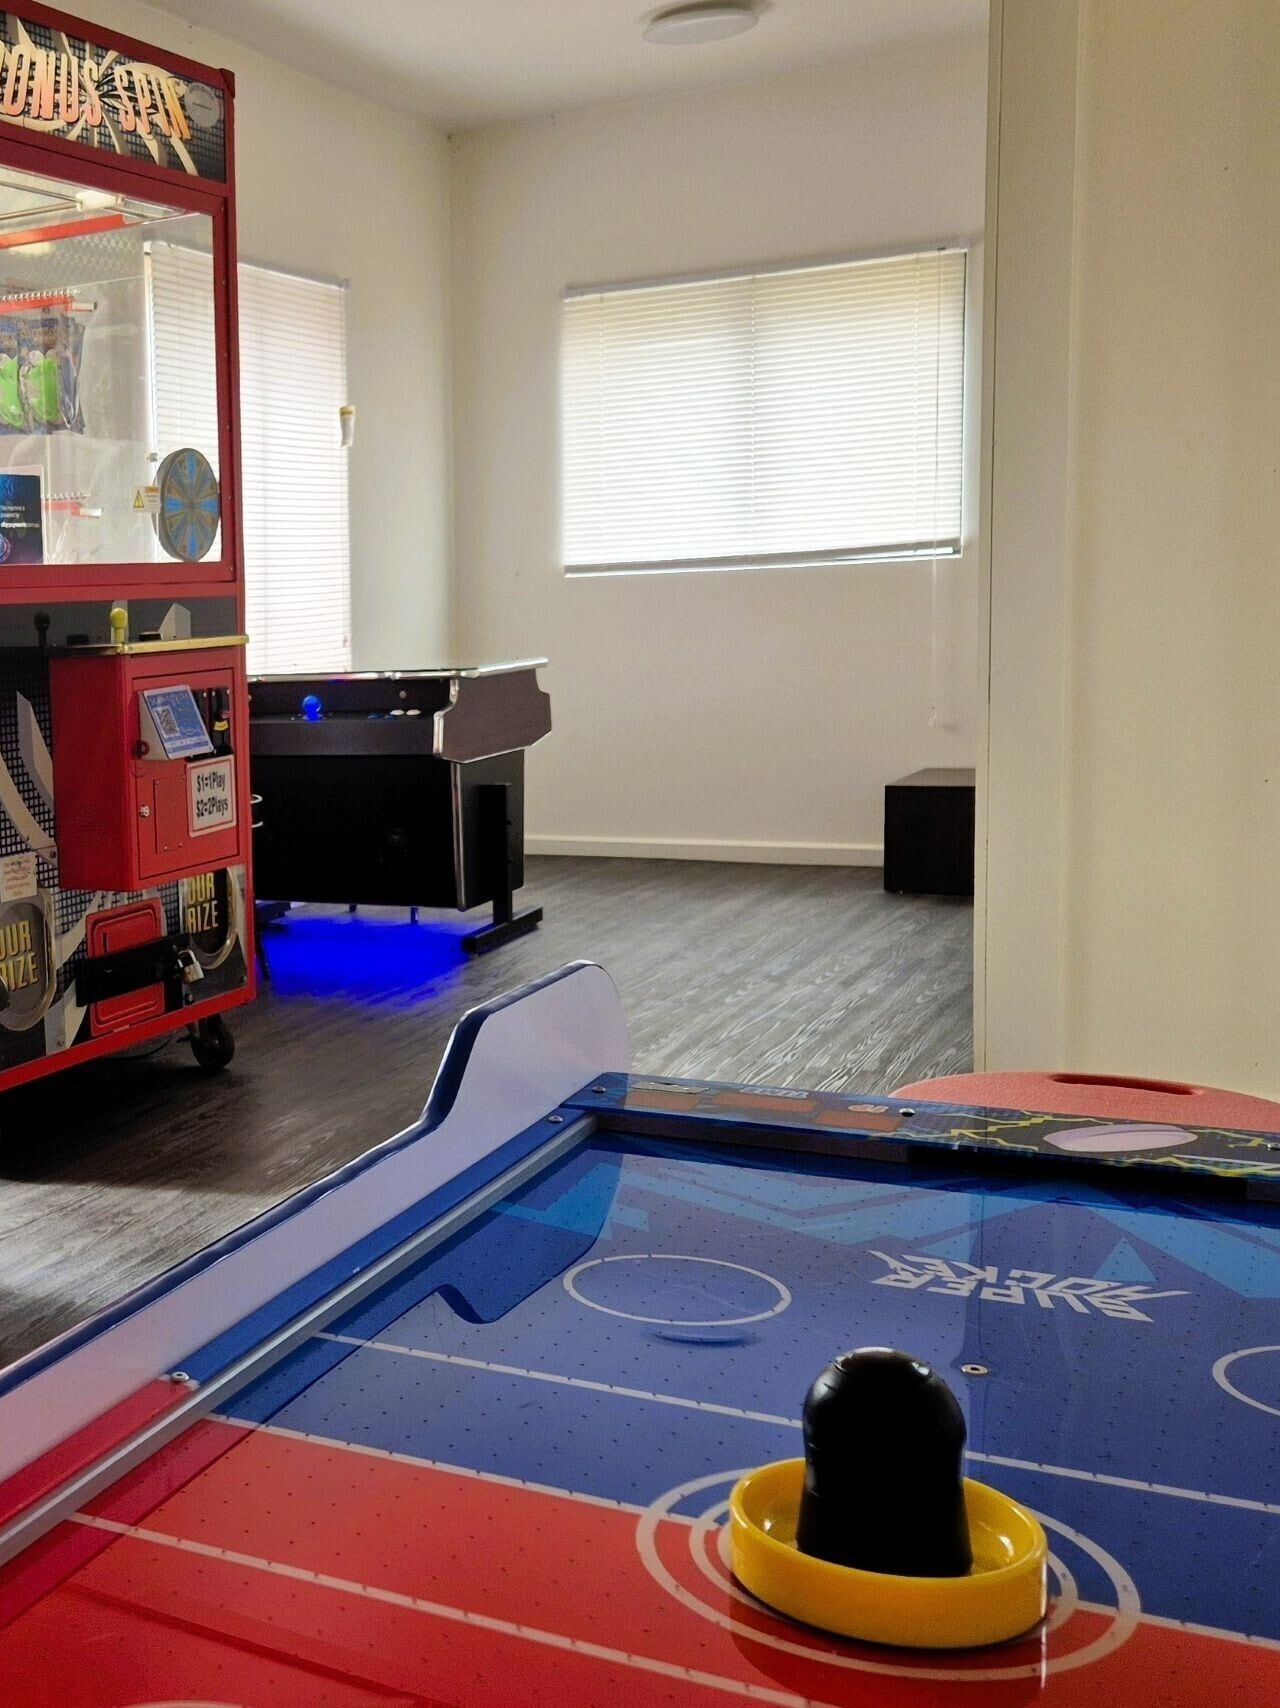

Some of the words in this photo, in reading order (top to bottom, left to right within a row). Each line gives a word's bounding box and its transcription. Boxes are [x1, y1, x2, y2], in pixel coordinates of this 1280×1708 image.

[114, 65, 193, 141] SPIN
[188, 872, 215, 905] OUR
[187, 900, 219, 934] RIZE
[870, 1272, 1155, 1323] SUPER
